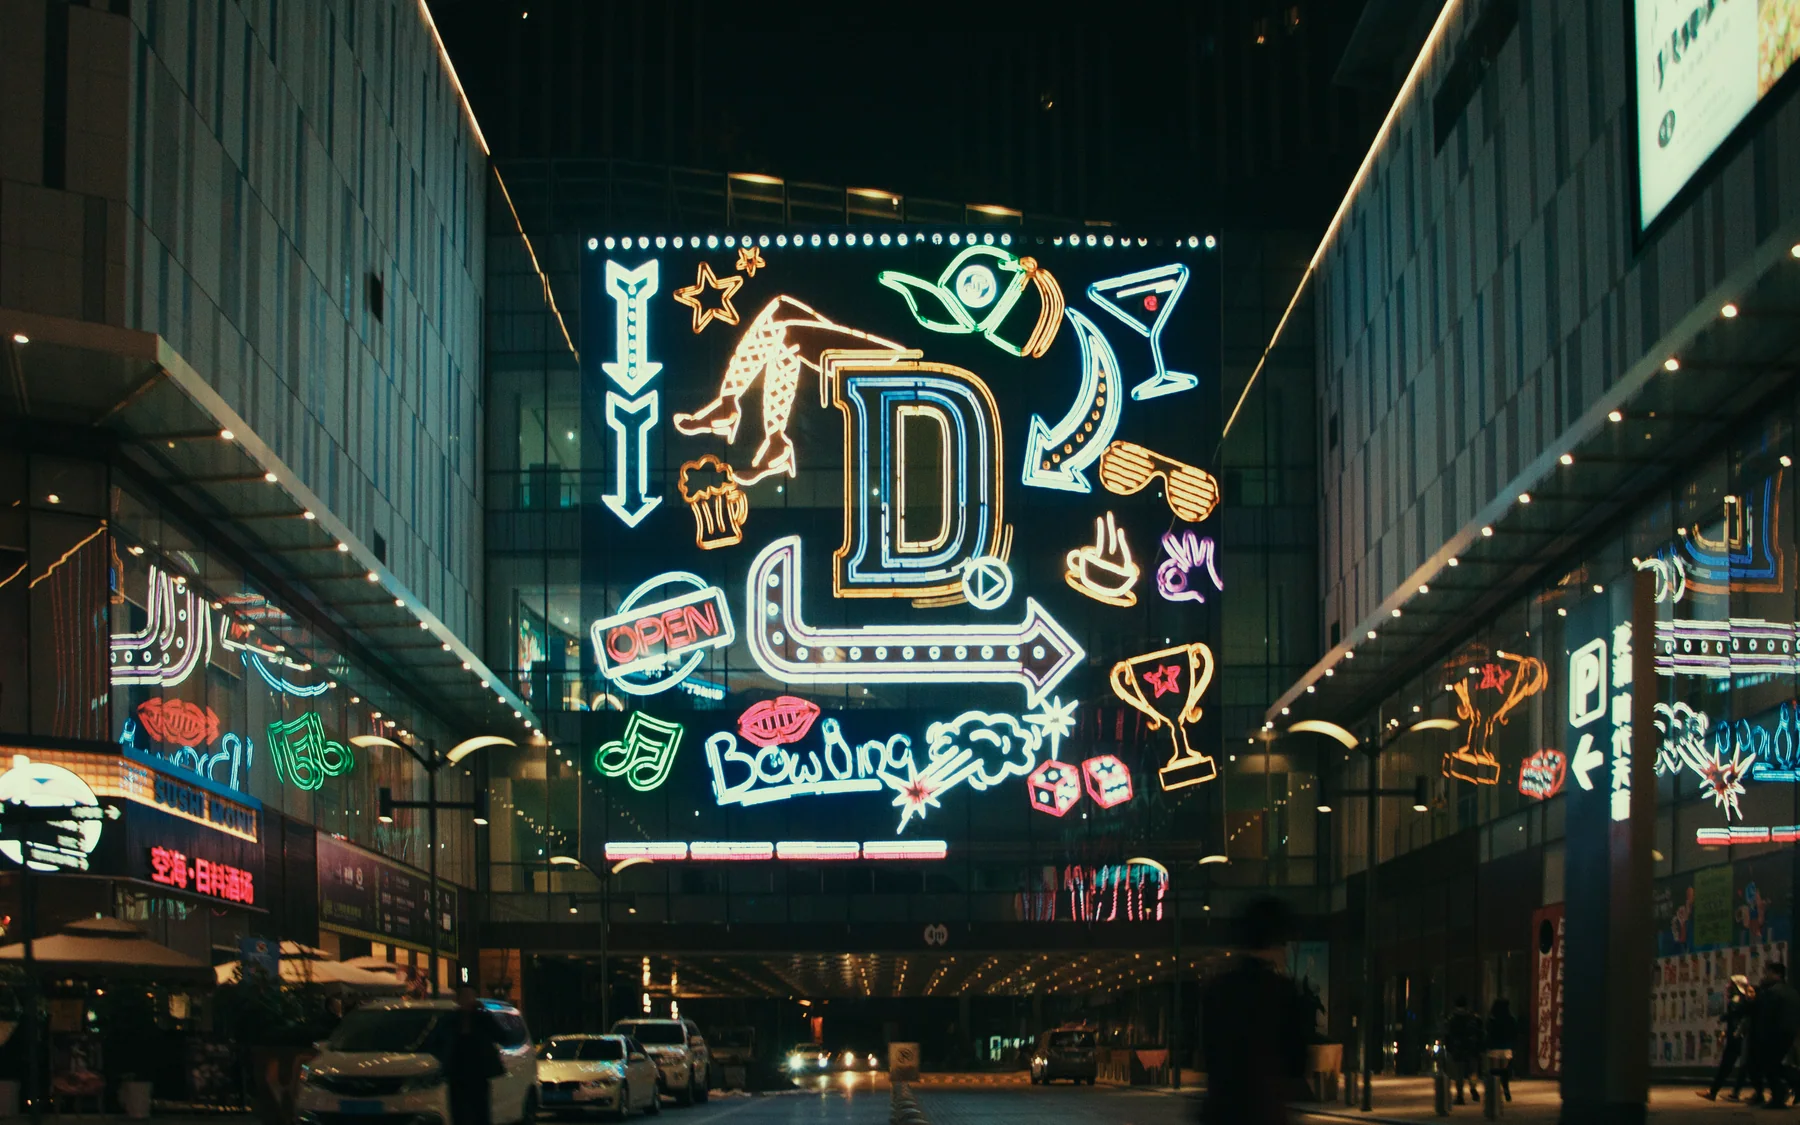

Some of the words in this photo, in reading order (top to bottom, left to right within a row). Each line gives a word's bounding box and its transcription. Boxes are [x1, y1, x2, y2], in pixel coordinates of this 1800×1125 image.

[833, 361, 1004, 598] D
[606, 601, 719, 664] OPEN
[1577, 652, 1599, 717] P
[154, 774, 205, 818] SUSHI
